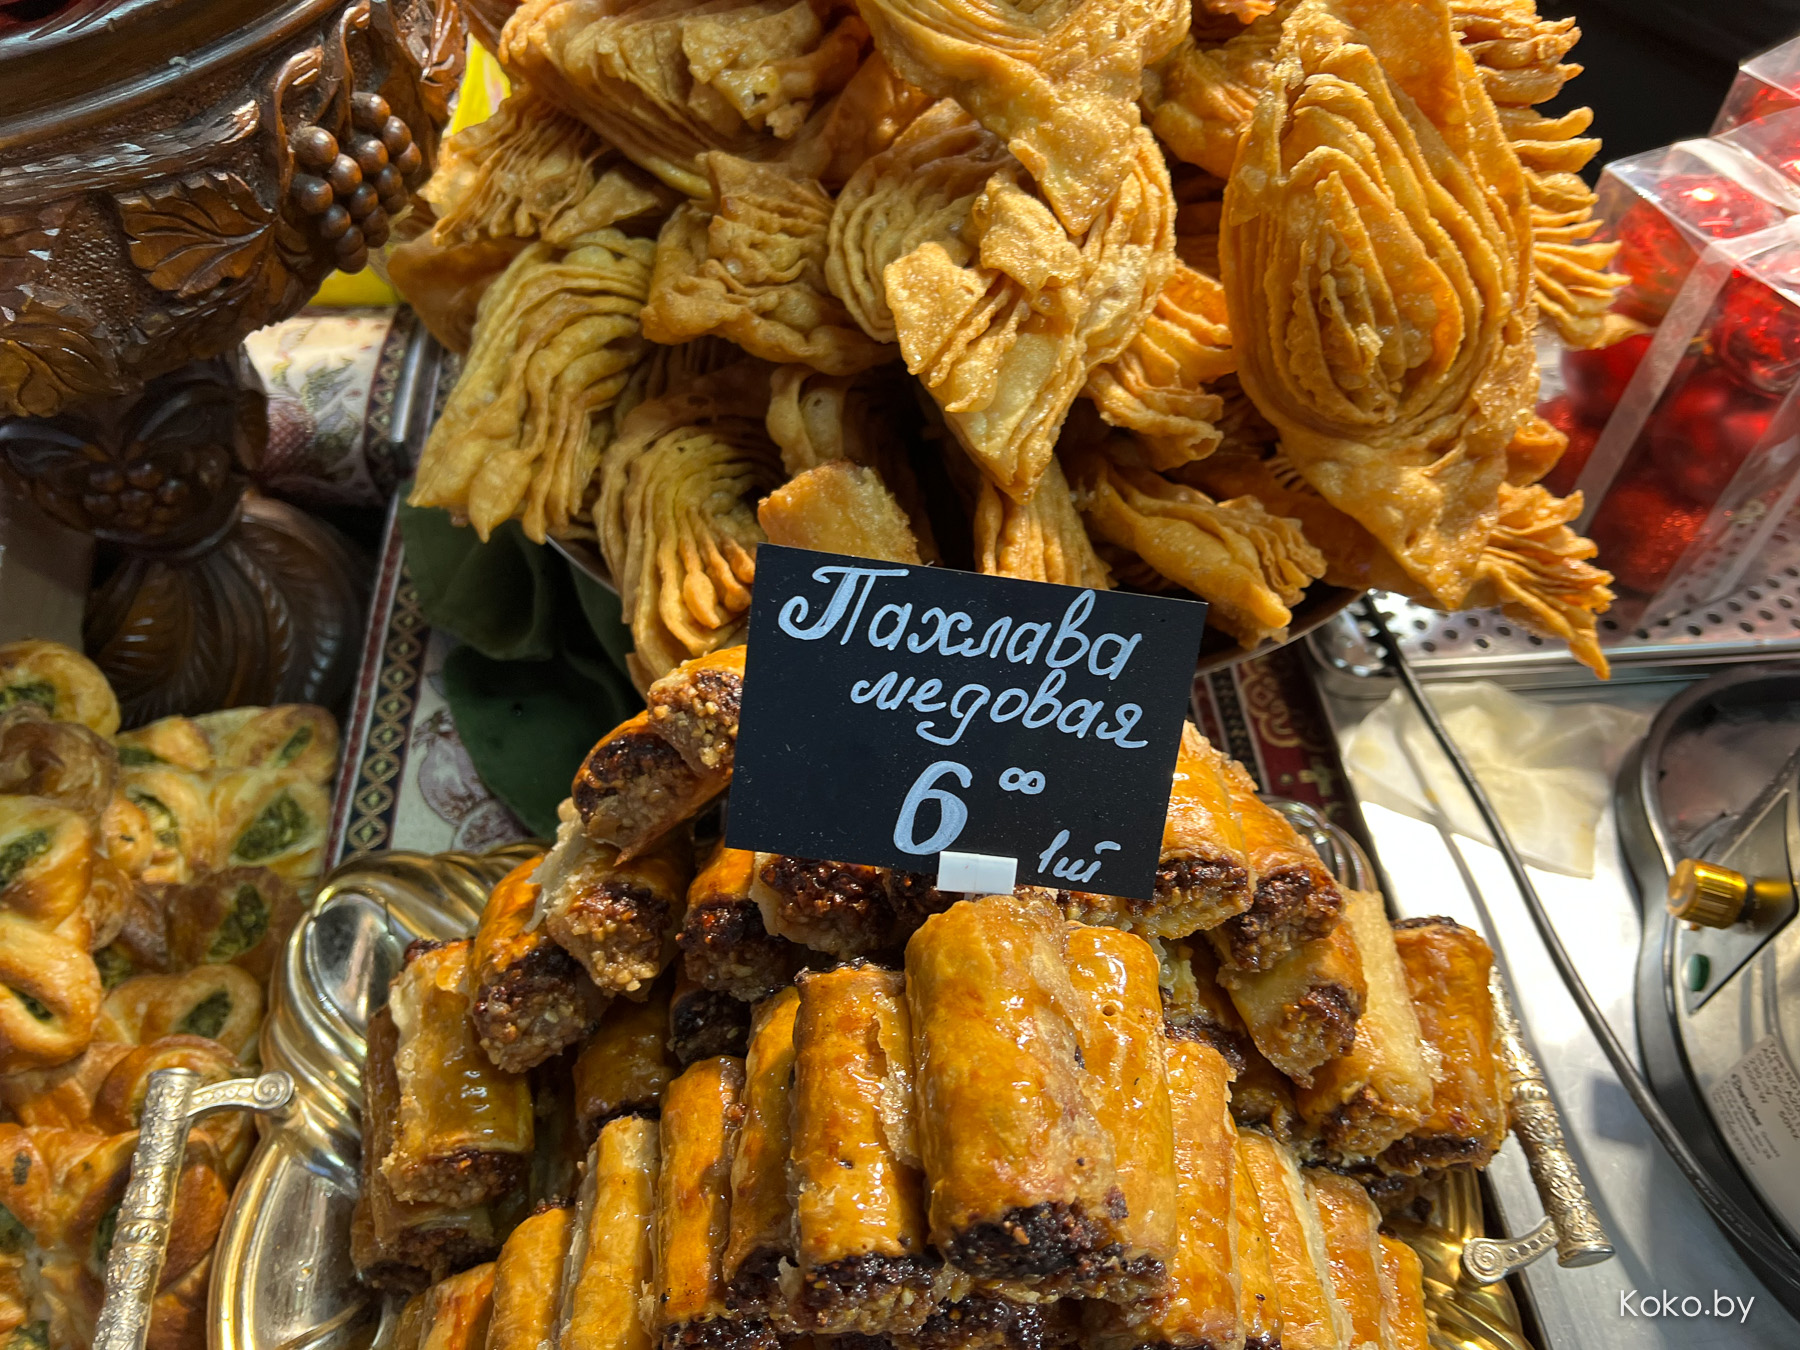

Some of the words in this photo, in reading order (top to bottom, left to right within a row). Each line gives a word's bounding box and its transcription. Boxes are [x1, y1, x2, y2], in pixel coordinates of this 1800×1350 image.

[777, 565, 1143, 681] Пахлава
[850, 668, 1149, 746] медовая
[893, 760, 972, 856] 6
